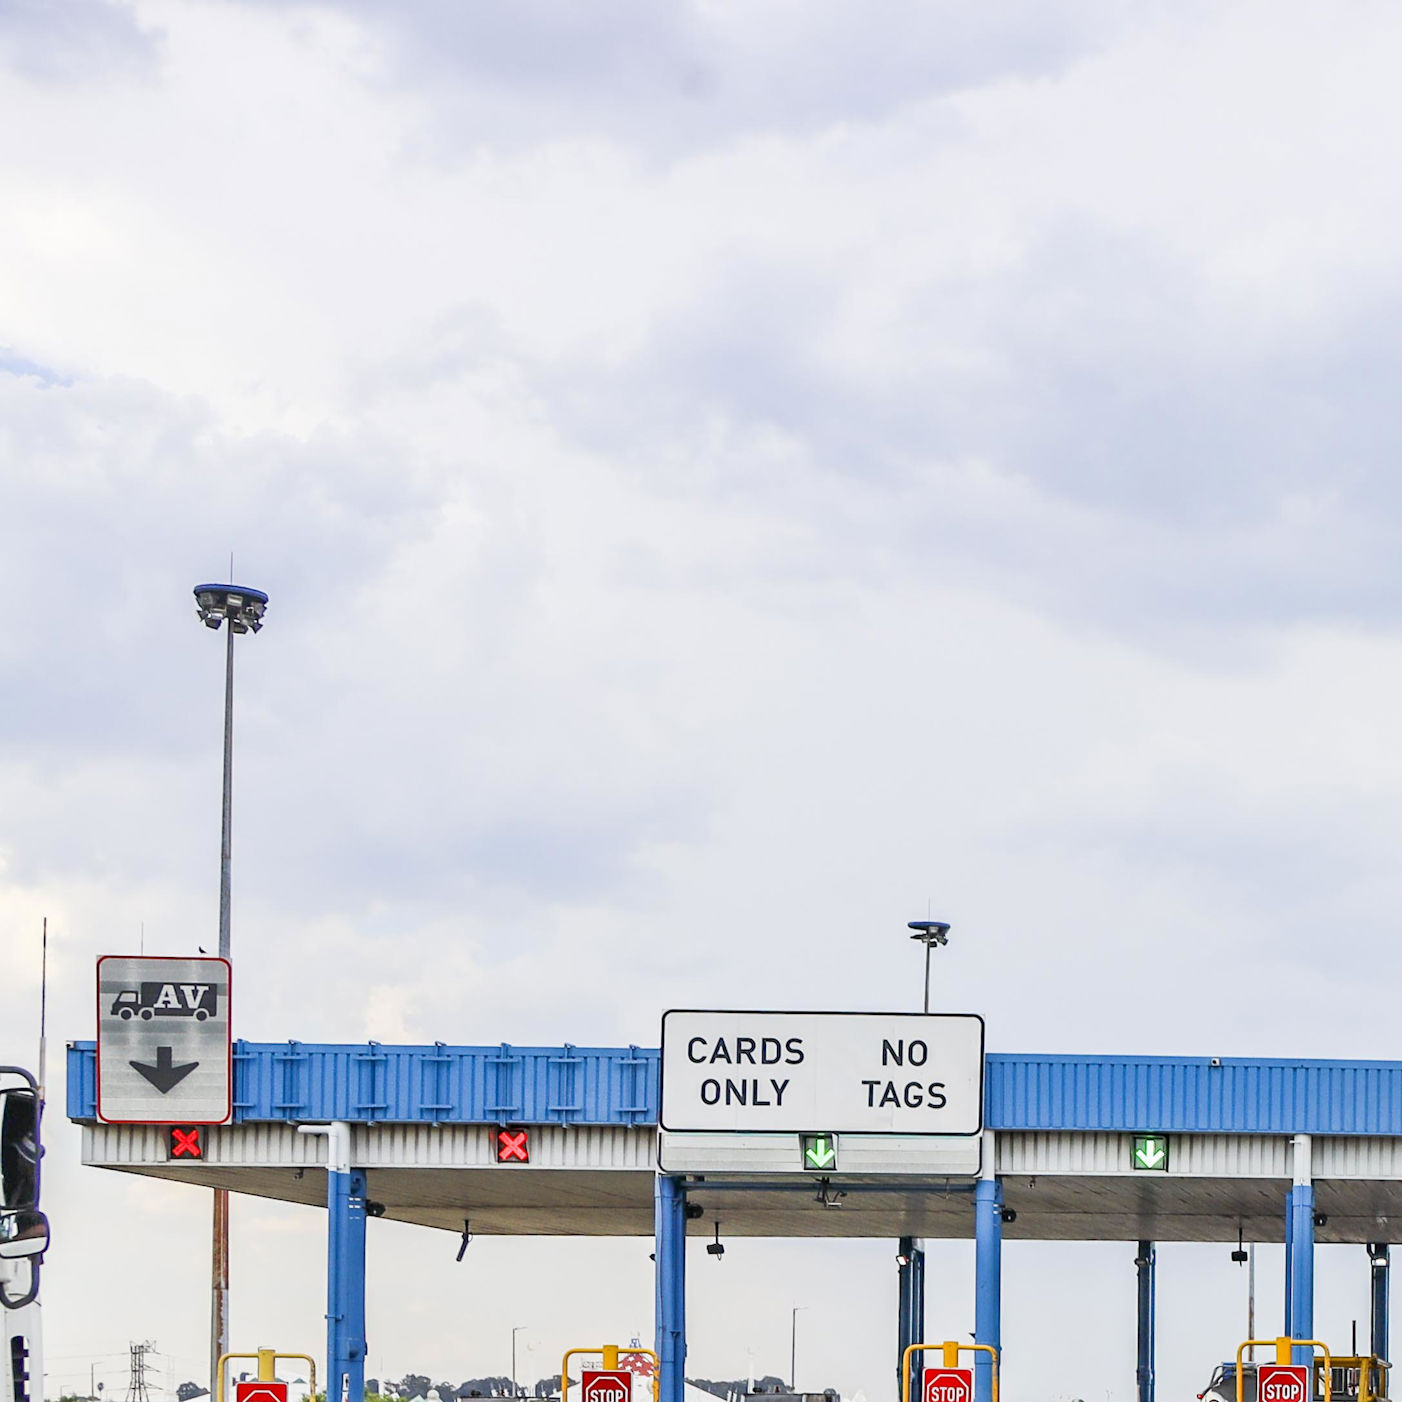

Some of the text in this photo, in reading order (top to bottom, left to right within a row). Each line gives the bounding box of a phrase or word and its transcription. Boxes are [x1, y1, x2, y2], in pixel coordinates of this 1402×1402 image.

[687, 1037, 805, 1065] CARDS
[881, 1039, 928, 1067] NO
[700, 1078, 790, 1106] ONLY
[861, 1080, 947, 1109] TAGS
[931, 1386, 965, 1402] STOP
[1266, 1384, 1299, 1400] STOP
